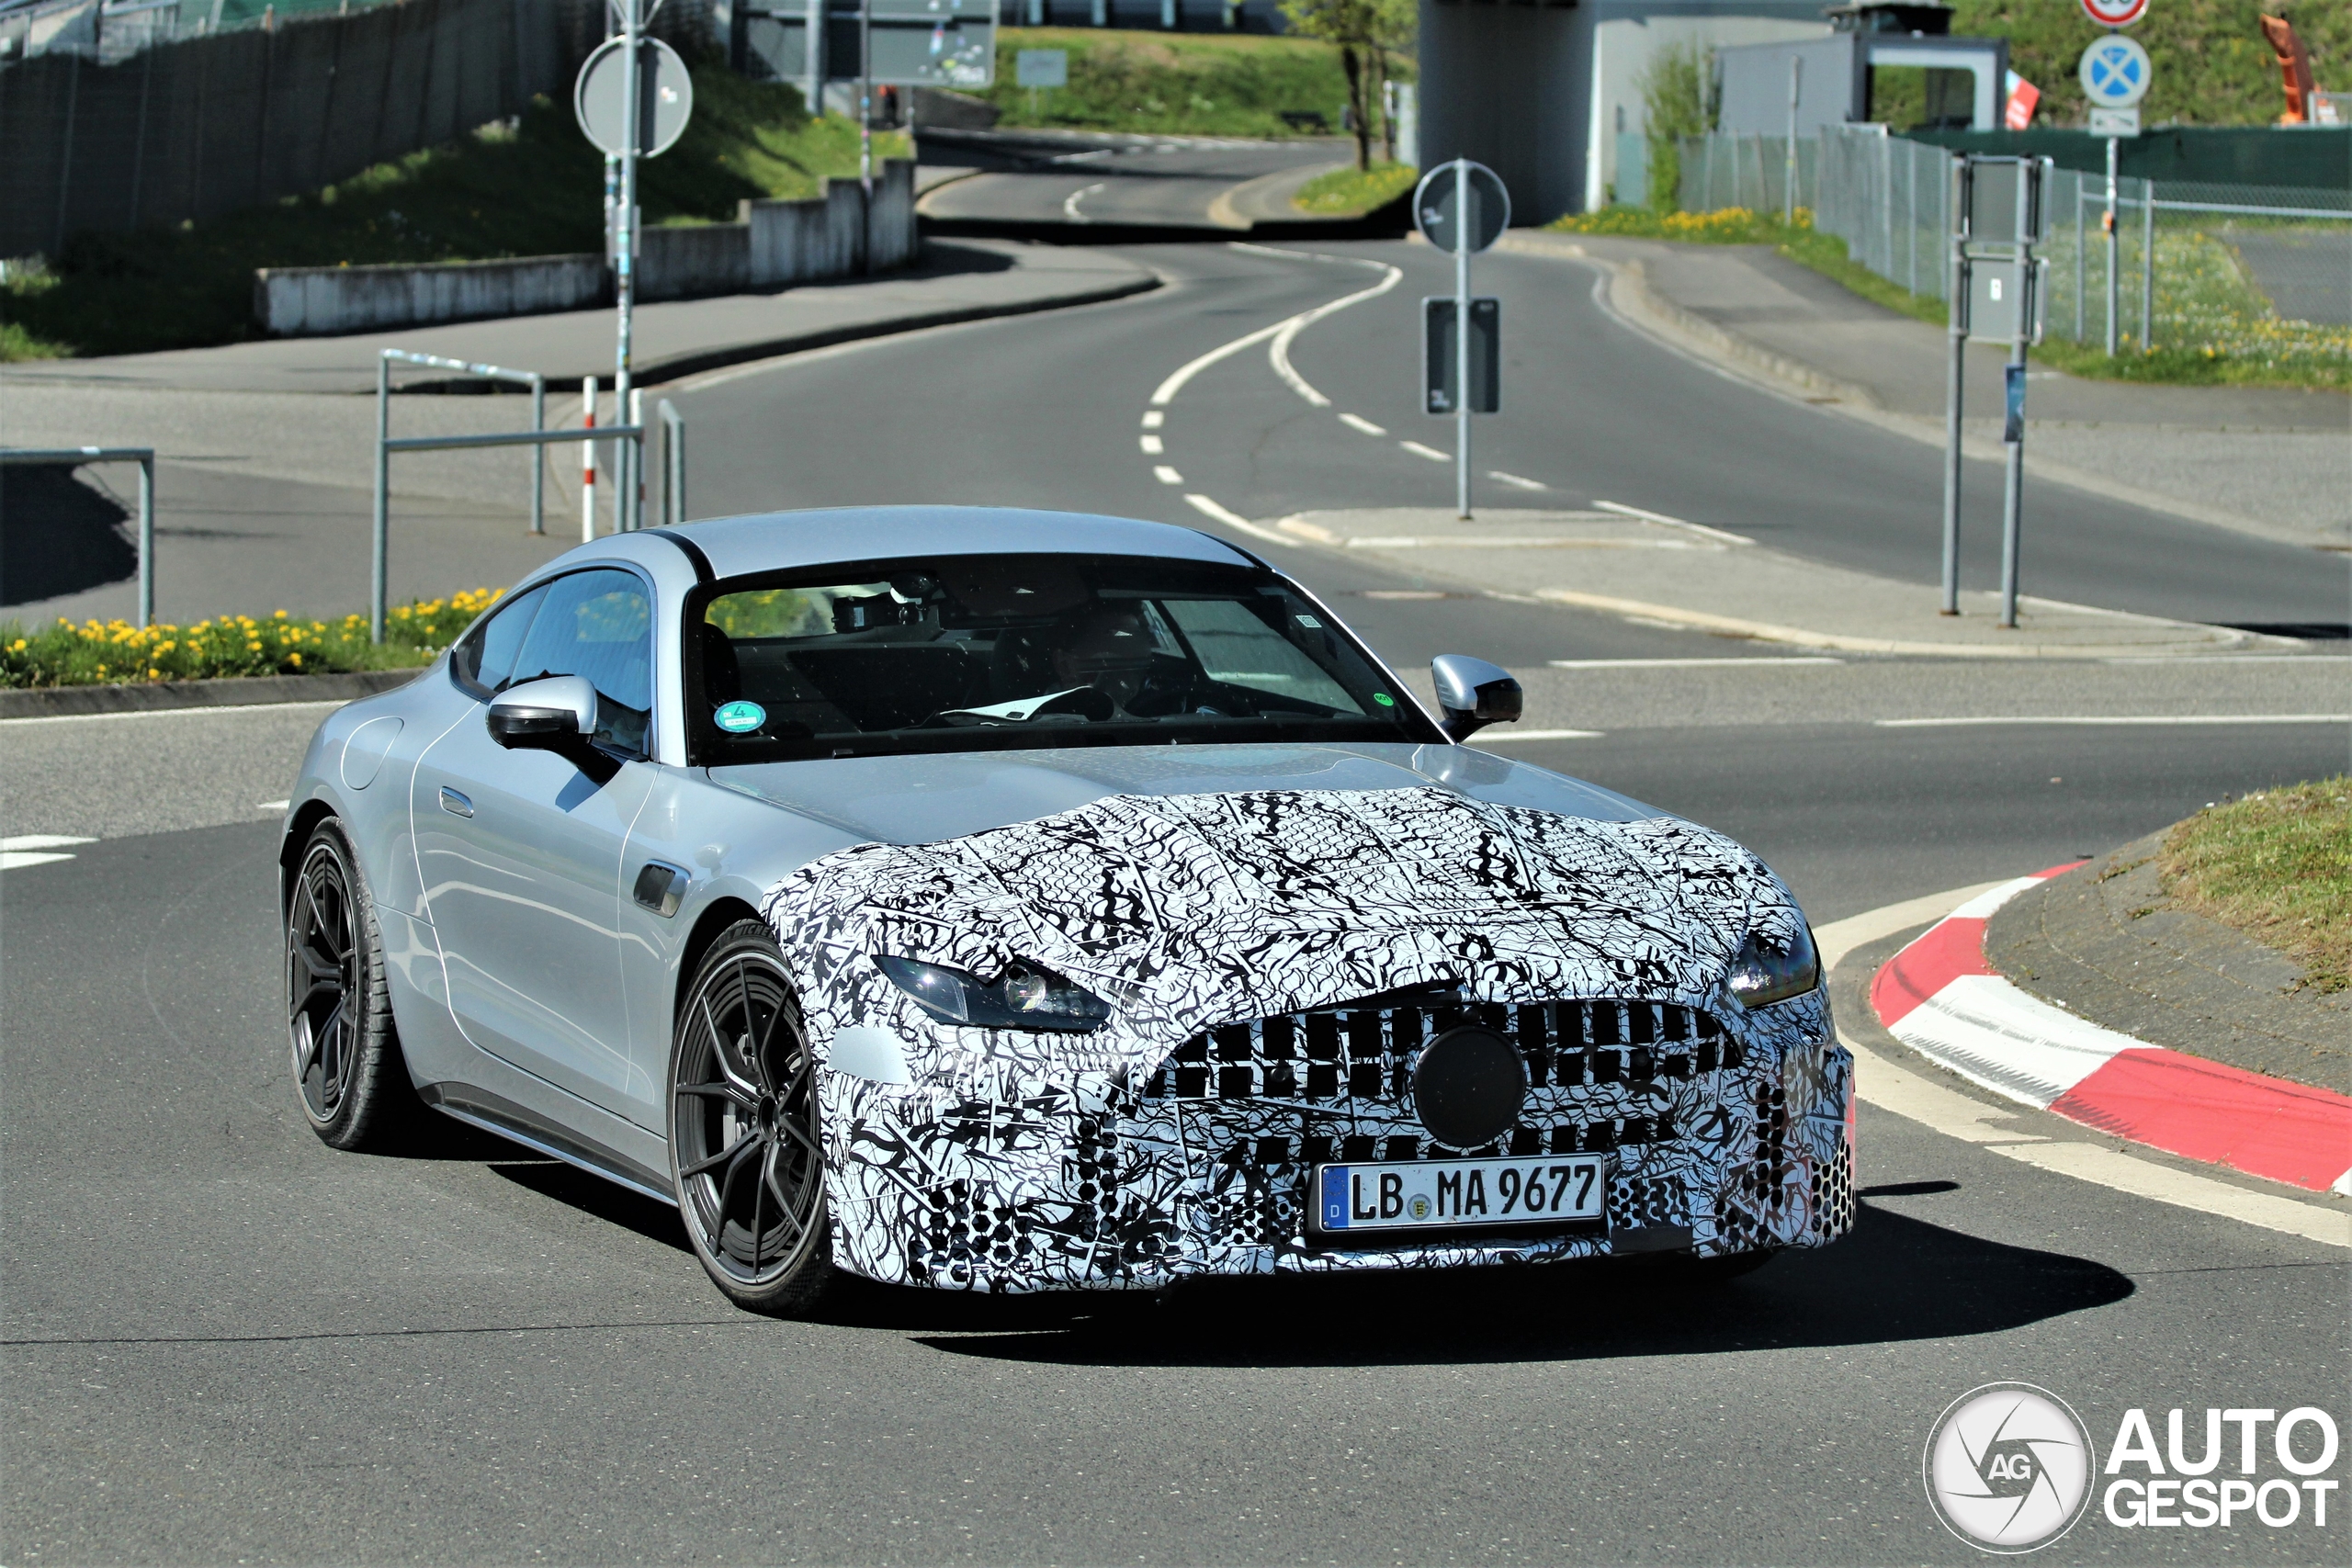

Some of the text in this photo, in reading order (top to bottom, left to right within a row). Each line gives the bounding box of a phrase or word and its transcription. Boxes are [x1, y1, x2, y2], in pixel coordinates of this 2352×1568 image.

[733, 705, 746, 717] 4
[1351, 1172, 1404, 1220] LB
[1437, 1169, 1487, 1217] MA
[1498, 1164, 1596, 1214] 9677
[1329, 1204, 1340, 1218] D
